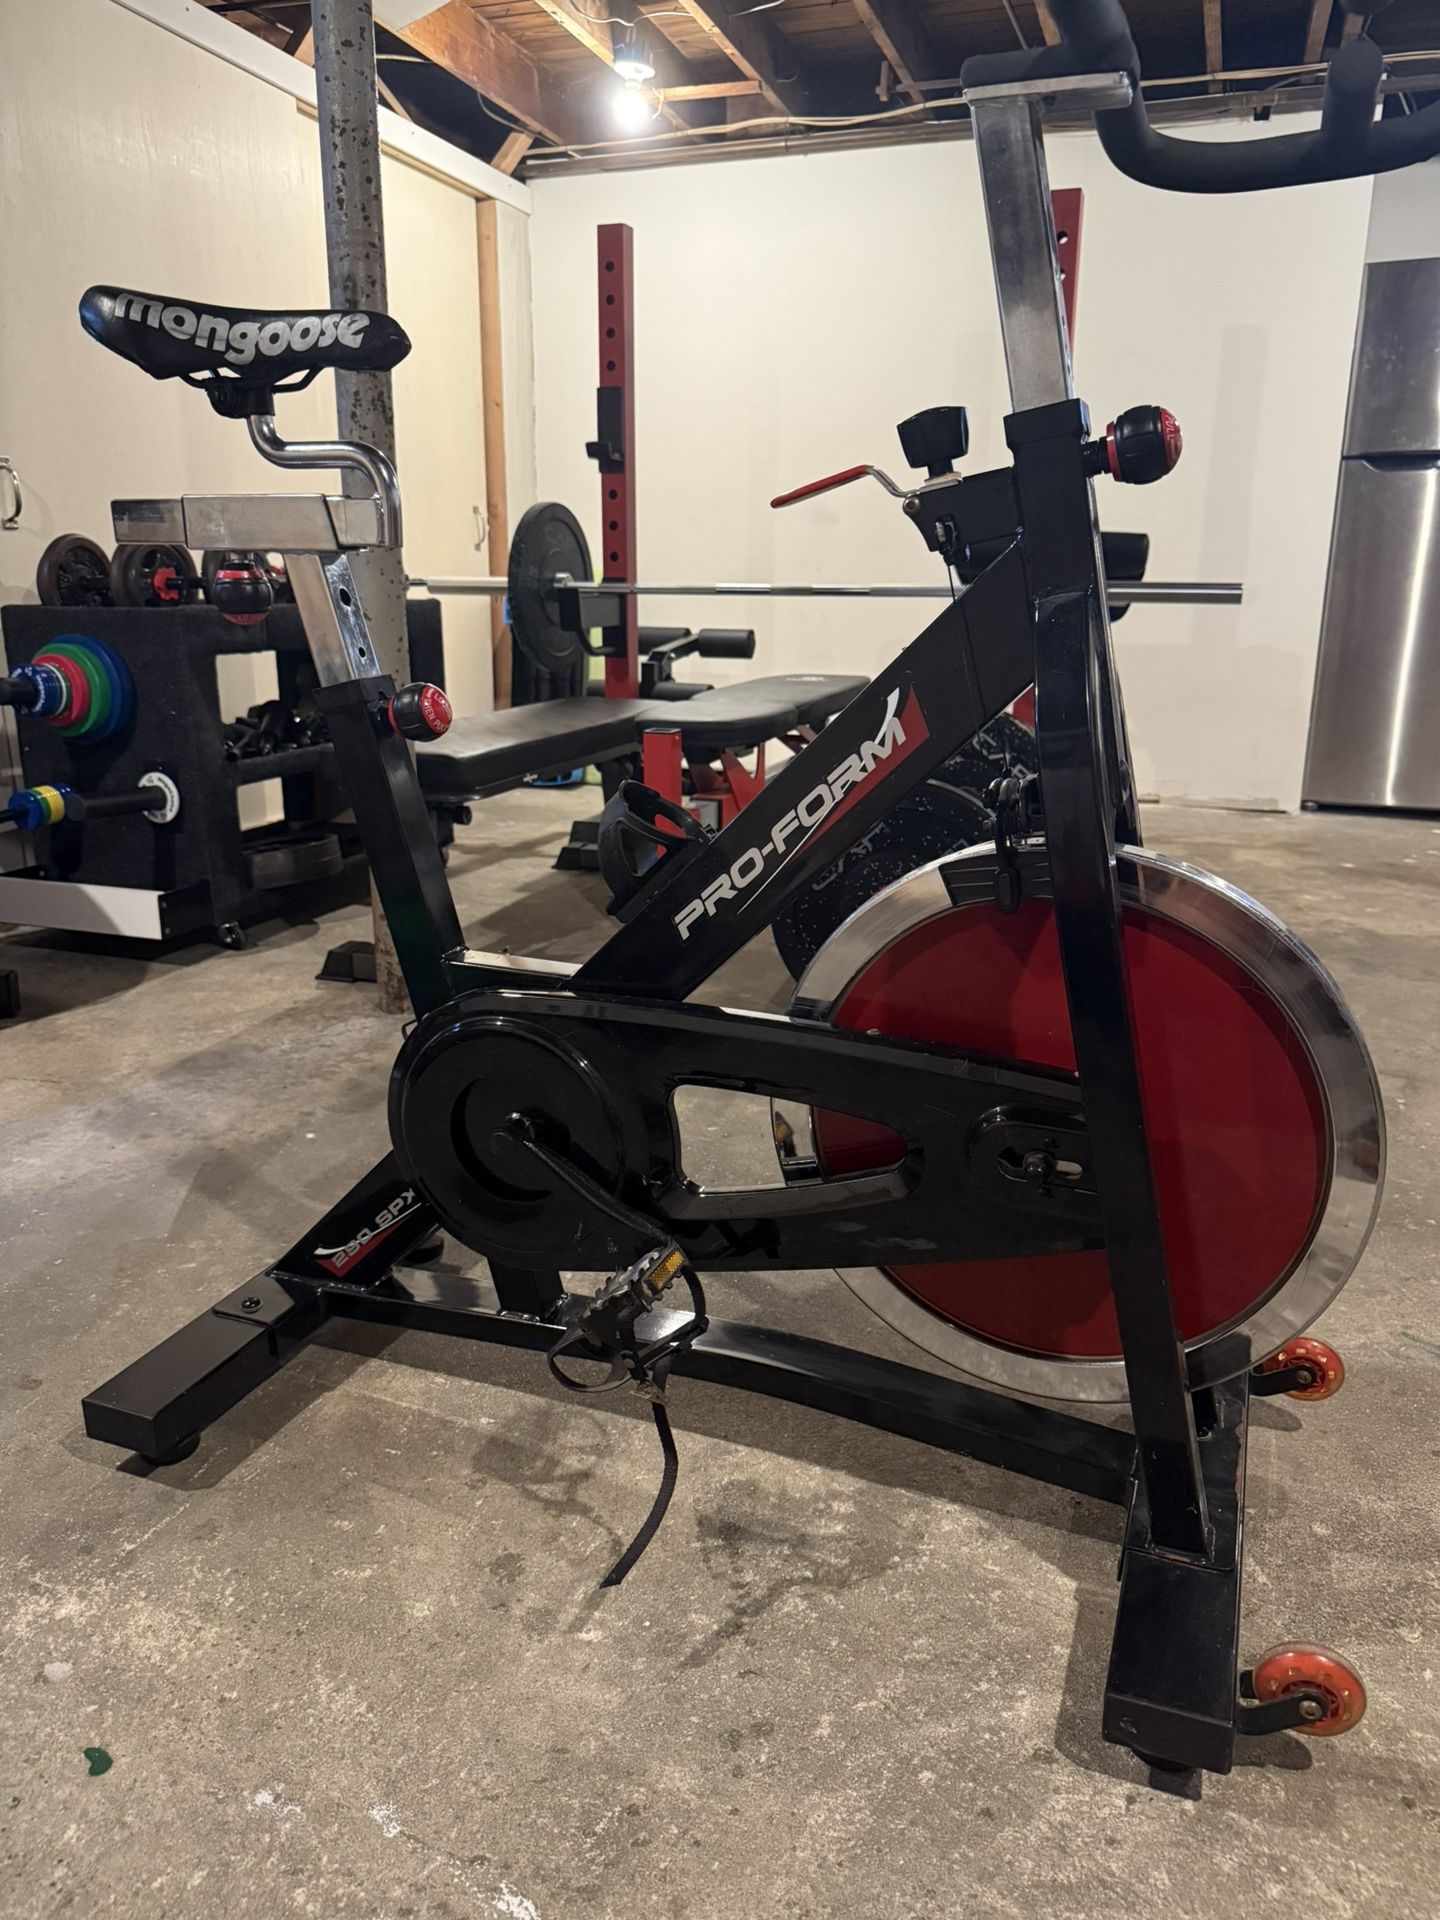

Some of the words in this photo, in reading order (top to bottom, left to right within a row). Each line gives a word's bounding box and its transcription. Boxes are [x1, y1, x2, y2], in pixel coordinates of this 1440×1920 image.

[114, 292, 370, 365] mongoose
[673, 716, 906, 941] PRO-FORM
[375, 1187, 416, 1228] SPX
